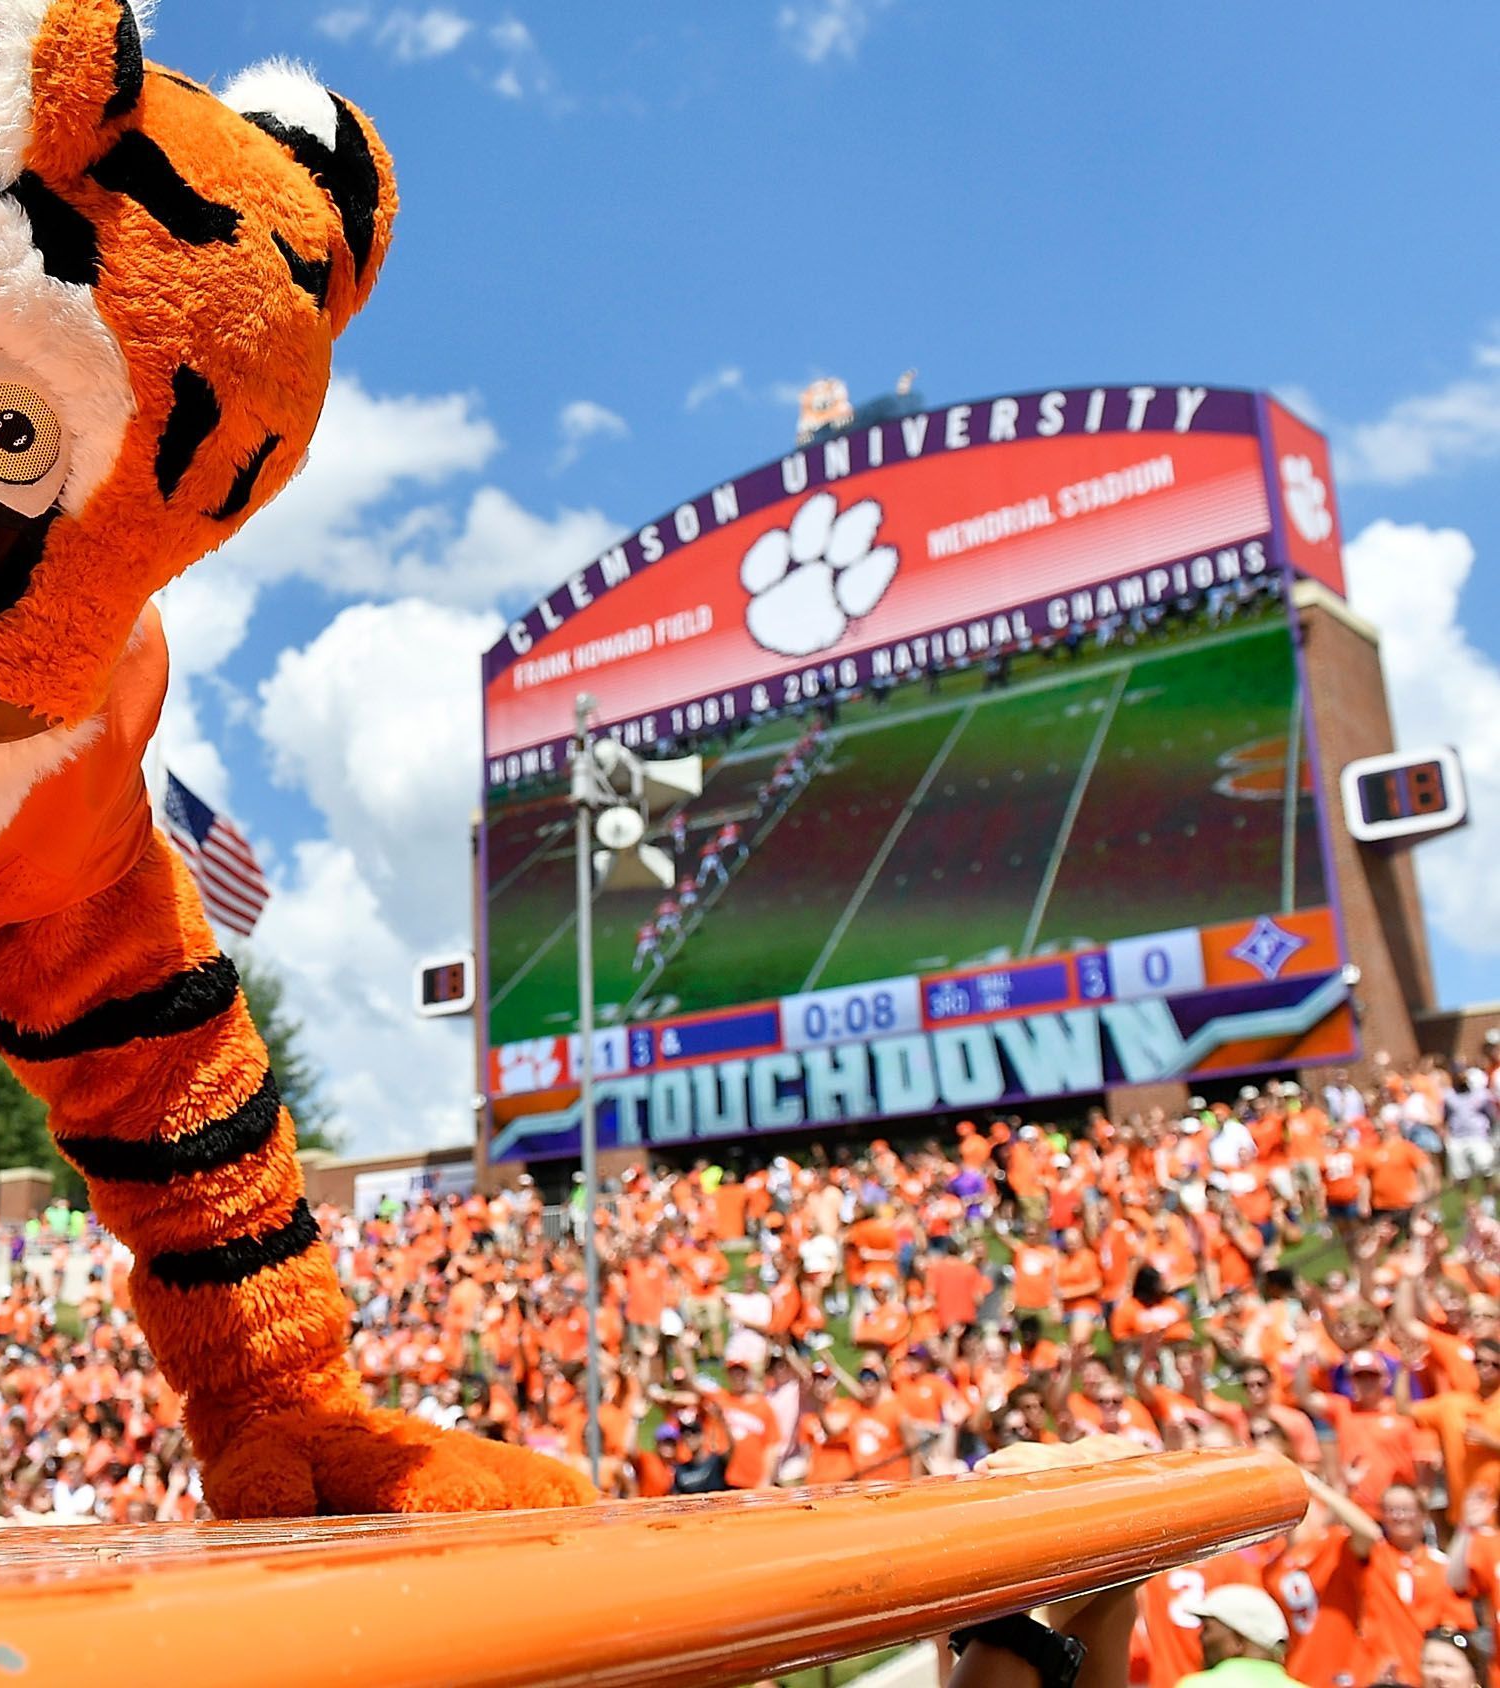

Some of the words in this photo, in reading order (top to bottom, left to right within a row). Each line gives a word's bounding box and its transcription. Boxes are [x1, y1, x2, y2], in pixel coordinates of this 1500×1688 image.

[508, 481, 740, 655] CLEMSON
[781, 386, 1207, 494] UNIVERSITY
[927, 495, 1056, 560] MEMORIAL
[1057, 454, 1176, 518] STADIUM
[490, 745, 554, 785] HOME
[751, 684, 769, 712] &
[871, 610, 1032, 678] NATIONAL
[1047, 541, 1267, 629] CHAMPIONS
[513, 650, 573, 690] FRANK
[573, 624, 653, 671] HOWARD
[654, 604, 713, 647] FIELD
[804, 992, 896, 1040] 0:08
[1143, 948, 1172, 987] 0
[605, 996, 1190, 1145] TOUCHDOWN
